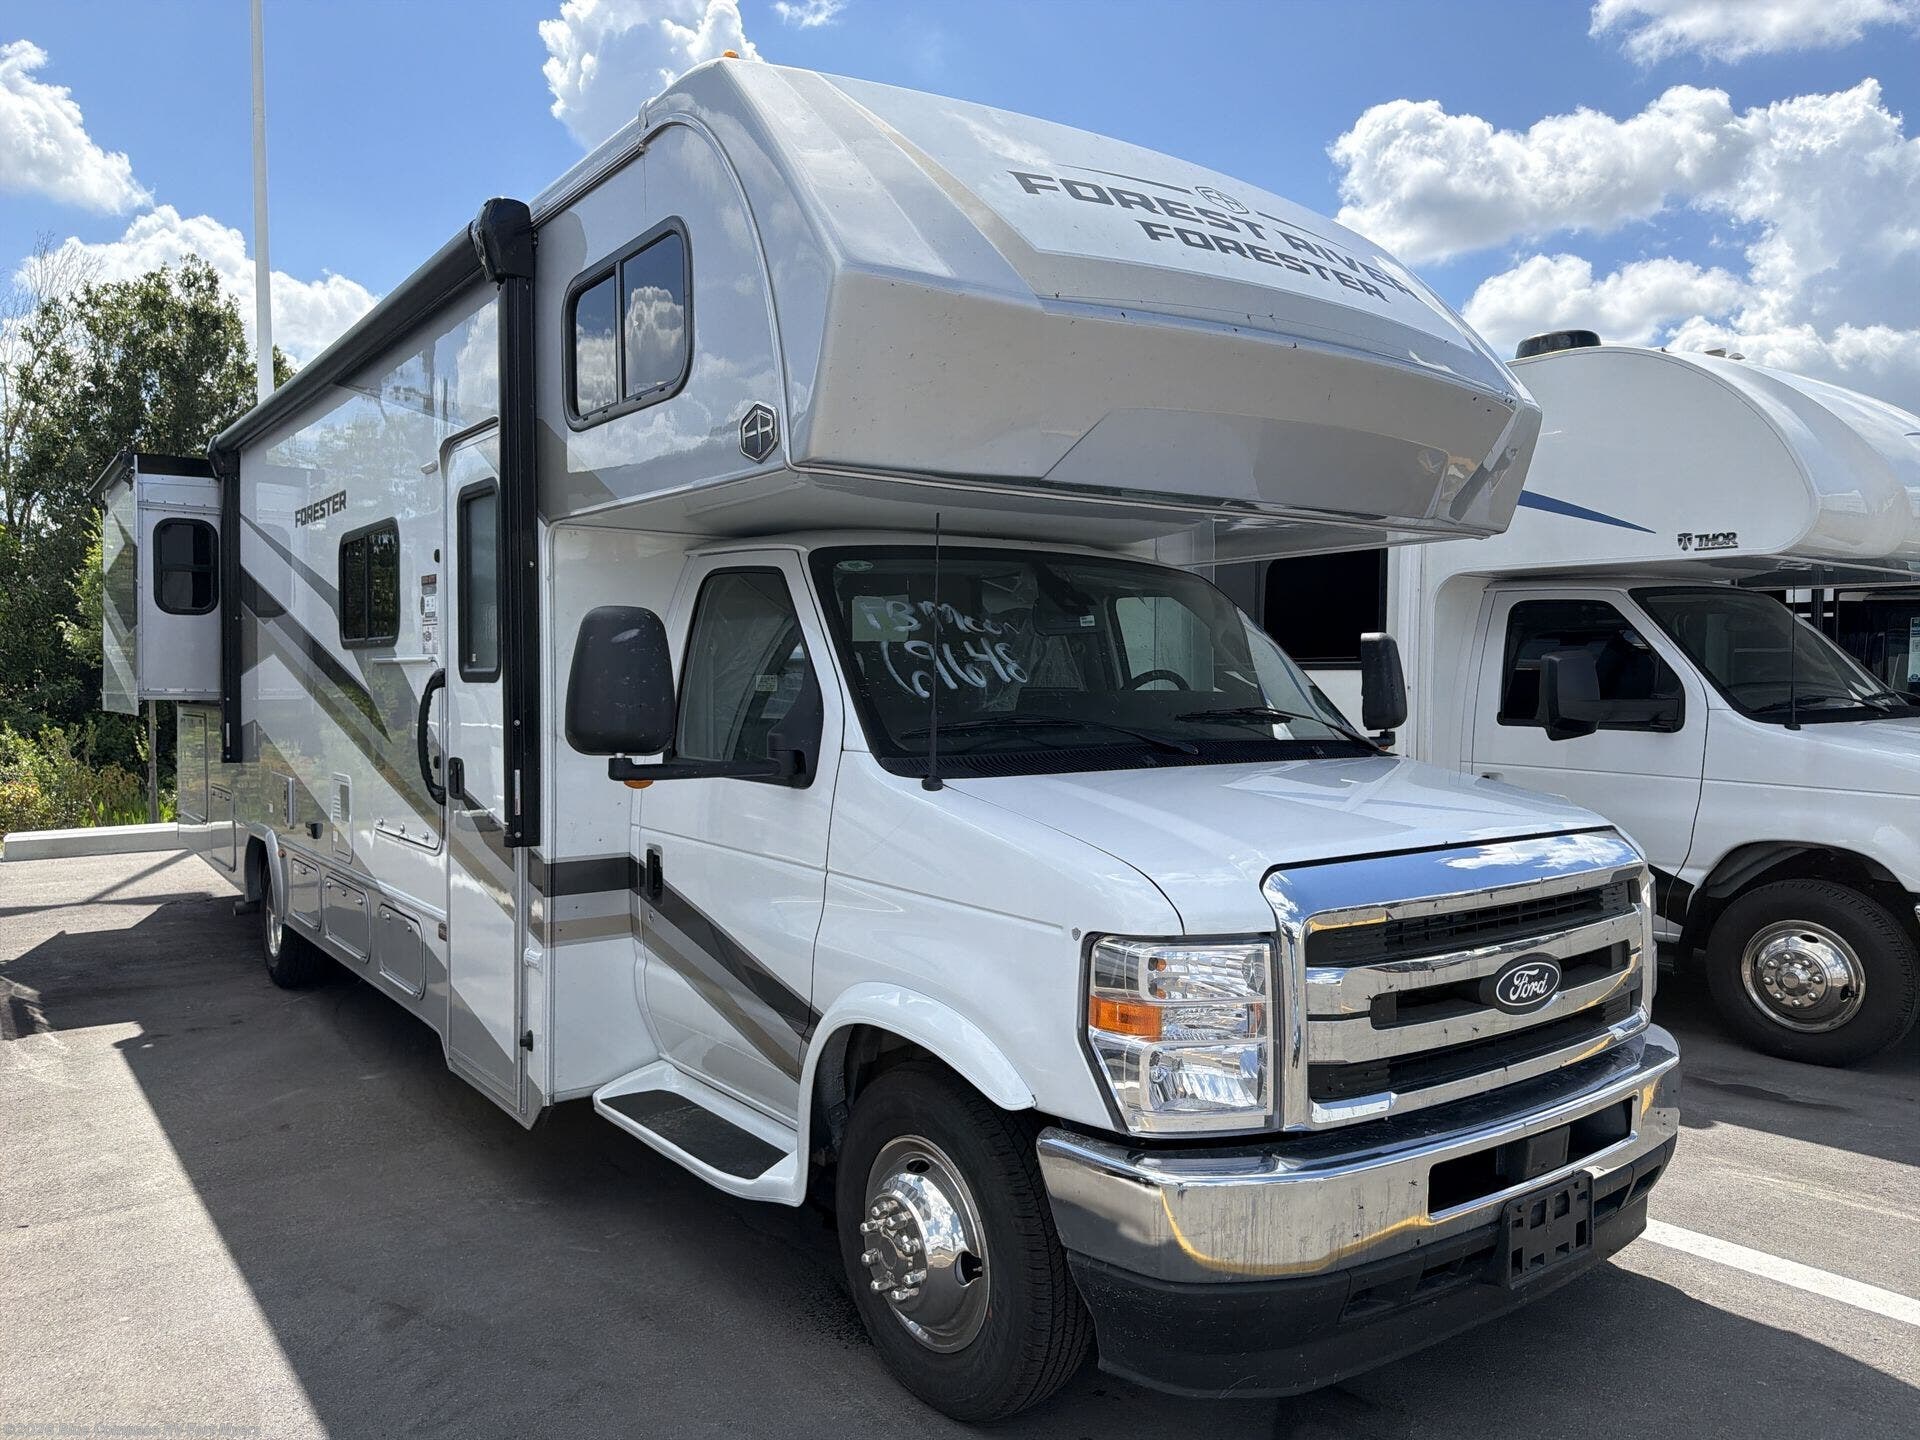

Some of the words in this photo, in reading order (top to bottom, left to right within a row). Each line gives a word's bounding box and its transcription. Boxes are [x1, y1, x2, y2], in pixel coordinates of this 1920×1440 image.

[1008, 170, 1267, 240] FOREST
[1278, 230, 1421, 302] RIVER
[1135, 219, 1391, 303] FORESTER
[295, 489, 347, 528] FORESTER
[1694, 532, 1738, 547] THOR
[1509, 968, 1549, 1001] Ford
